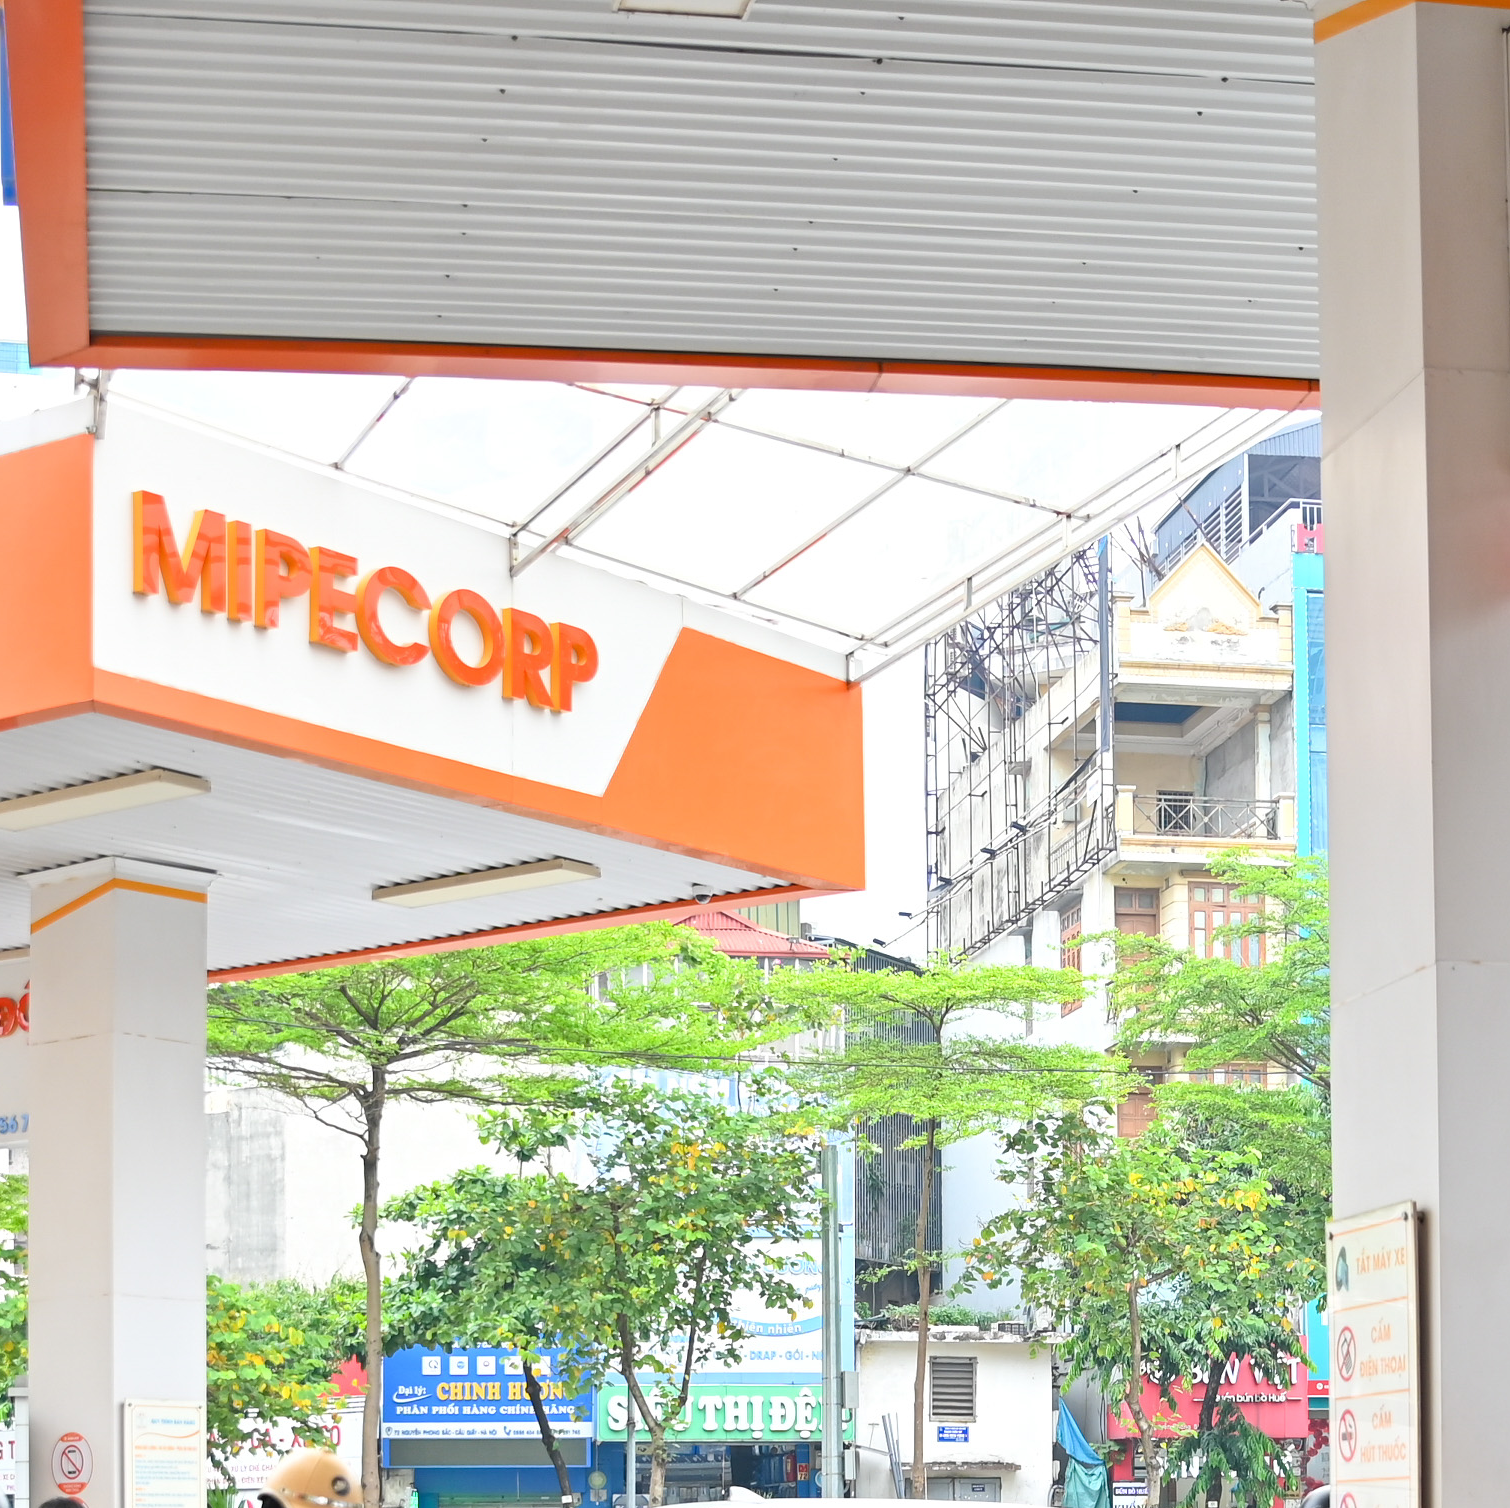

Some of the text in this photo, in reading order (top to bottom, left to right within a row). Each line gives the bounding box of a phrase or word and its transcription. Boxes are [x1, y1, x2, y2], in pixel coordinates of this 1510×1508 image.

[132, 490, 598, 712] MIPECORP
[1356, 1247, 1406, 1275] TẮT MÁY XE
[768, 1323, 802, 1334] nhiên
[1371, 1317, 1391, 1343] CẤM
[750, 1351, 776, 1360] DRAP
[1360, 1354, 1406, 1381] ĐIỆN THOẠI
[437, 1381, 501, 1401] CHINH
[396, 1404, 428, 1414] PHÂN
[432, 1402, 460, 1414] PHỐI
[462, 1404, 496, 1414] HÀNG
[698, 1395, 765, 1439] THỊ
[1372, 1405, 1392, 1430] CẤM
[1361, 1436, 1406, 1462] HÚT THUỐC
